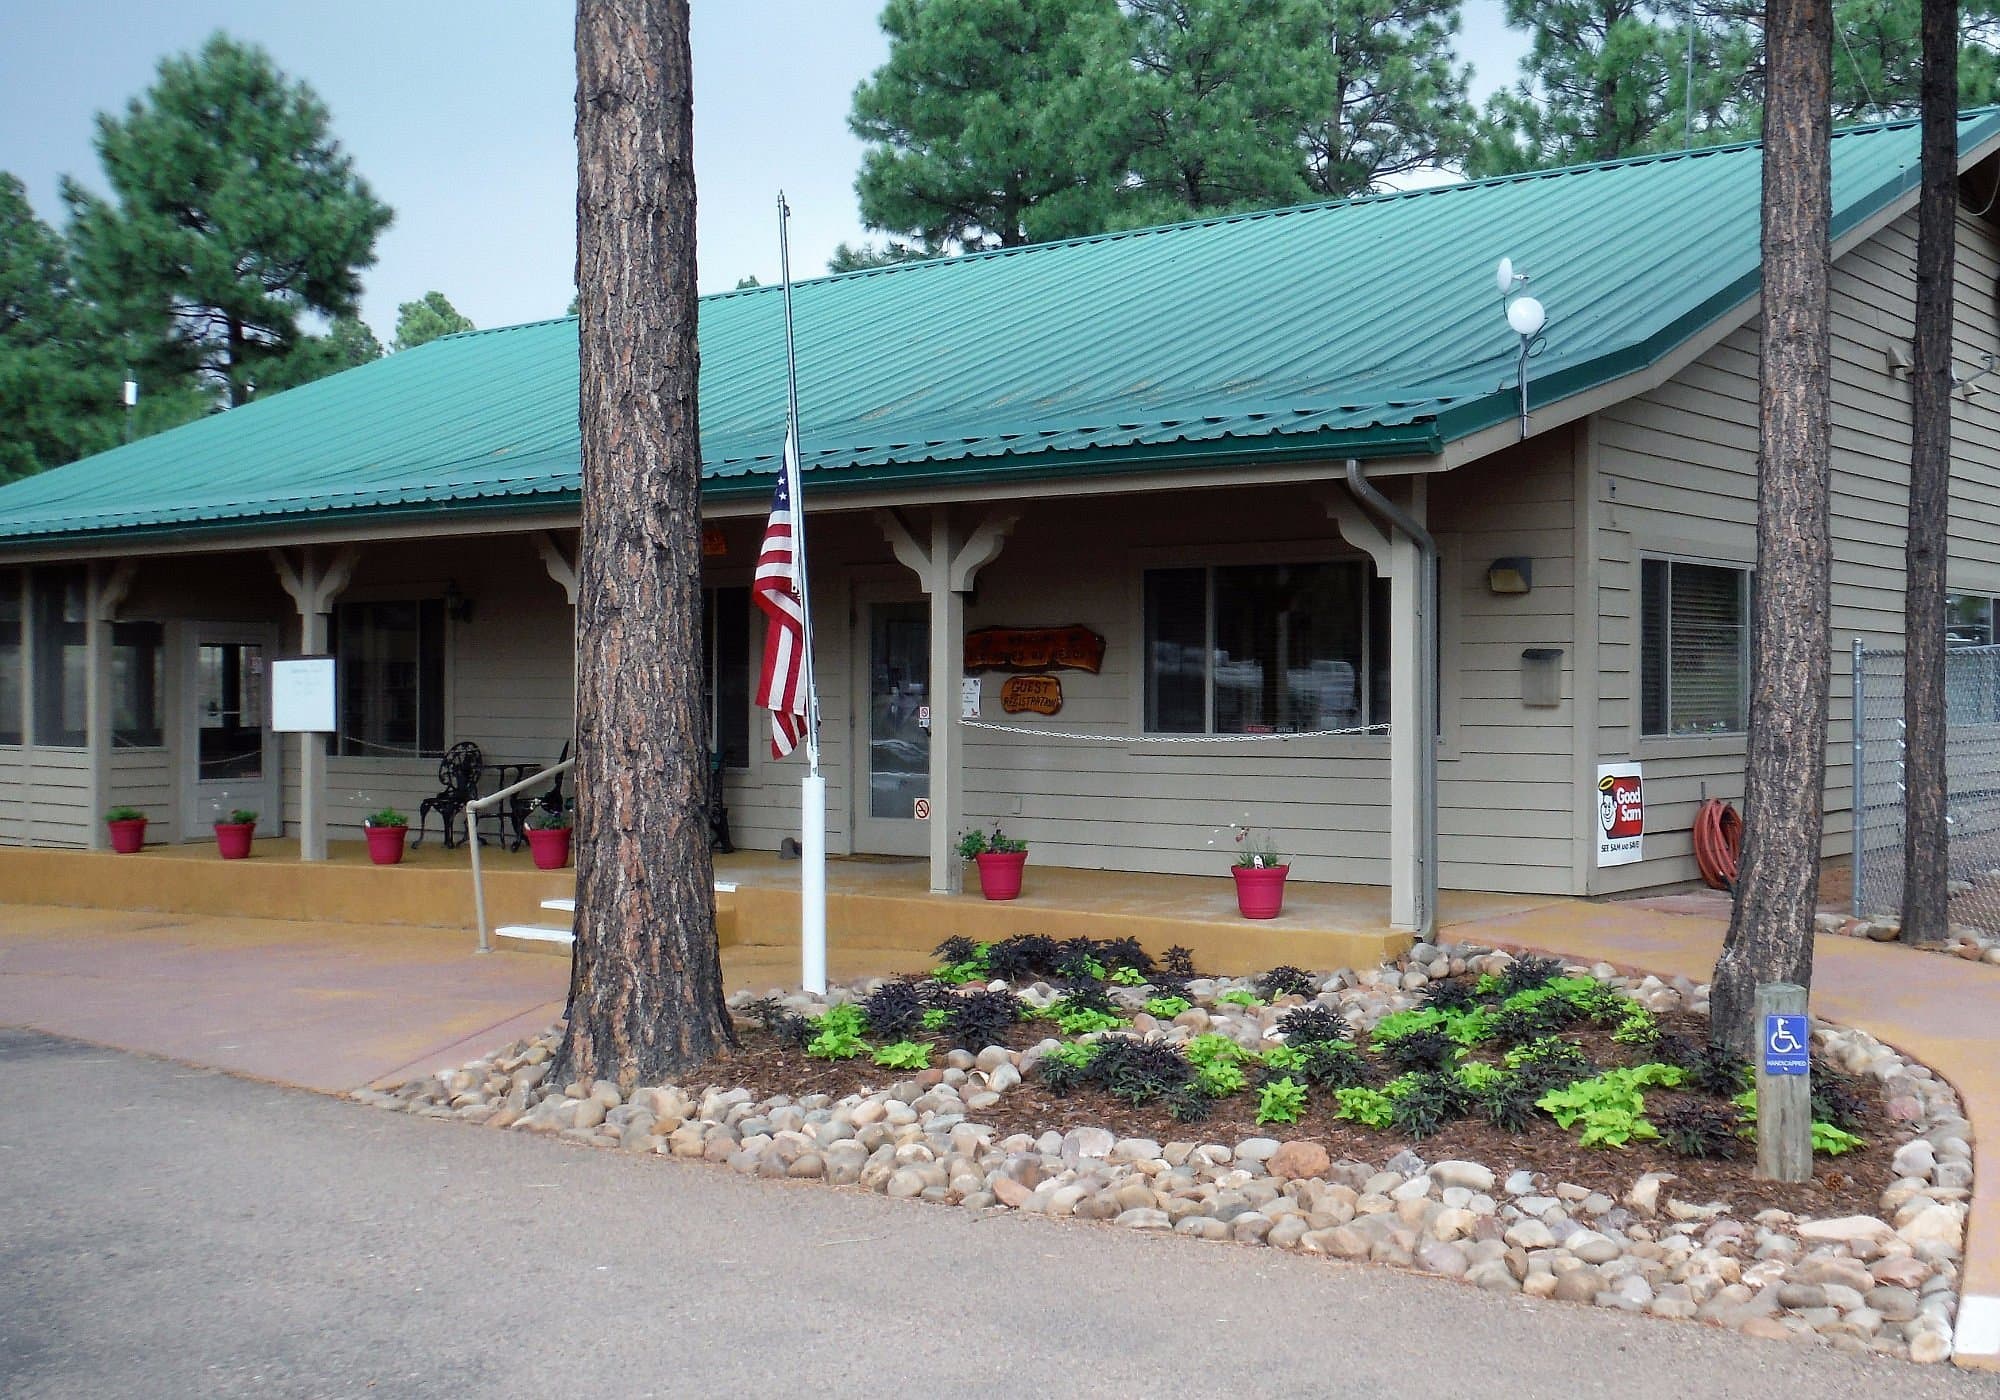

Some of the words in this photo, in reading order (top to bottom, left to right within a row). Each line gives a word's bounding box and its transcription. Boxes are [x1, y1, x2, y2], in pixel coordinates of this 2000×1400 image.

[1011, 681, 1049, 694] GUEST
[1616, 787, 1640, 804] Good
[1621, 804, 1641, 821] Sam
[1601, 844, 1610, 852] SEE
[1610, 842, 1621, 852] SAM
